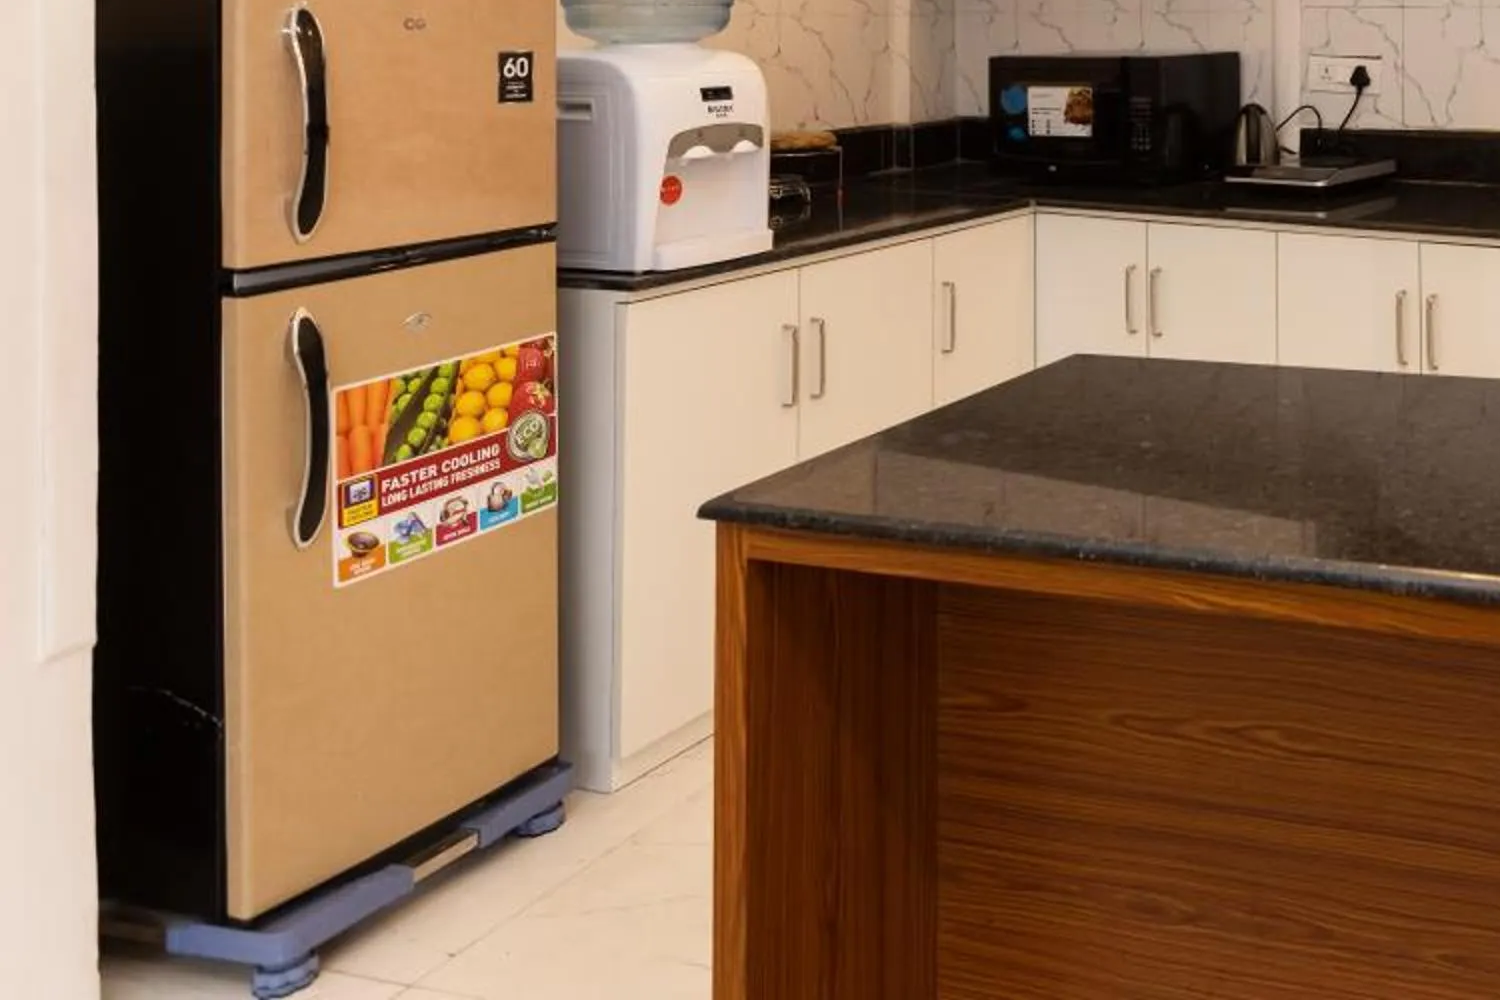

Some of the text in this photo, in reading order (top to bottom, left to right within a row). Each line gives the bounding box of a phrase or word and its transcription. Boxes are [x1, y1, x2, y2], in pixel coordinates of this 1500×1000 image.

[503, 57, 529, 78] 60
[514, 421, 540, 445] ECO
[381, 464, 438, 494] FASTER
[441, 443, 500, 473] COOLING
[381, 489, 408, 507] LONG
[409, 475, 449, 499] LASTING
[451, 458, 501, 484] FRESHNESS
